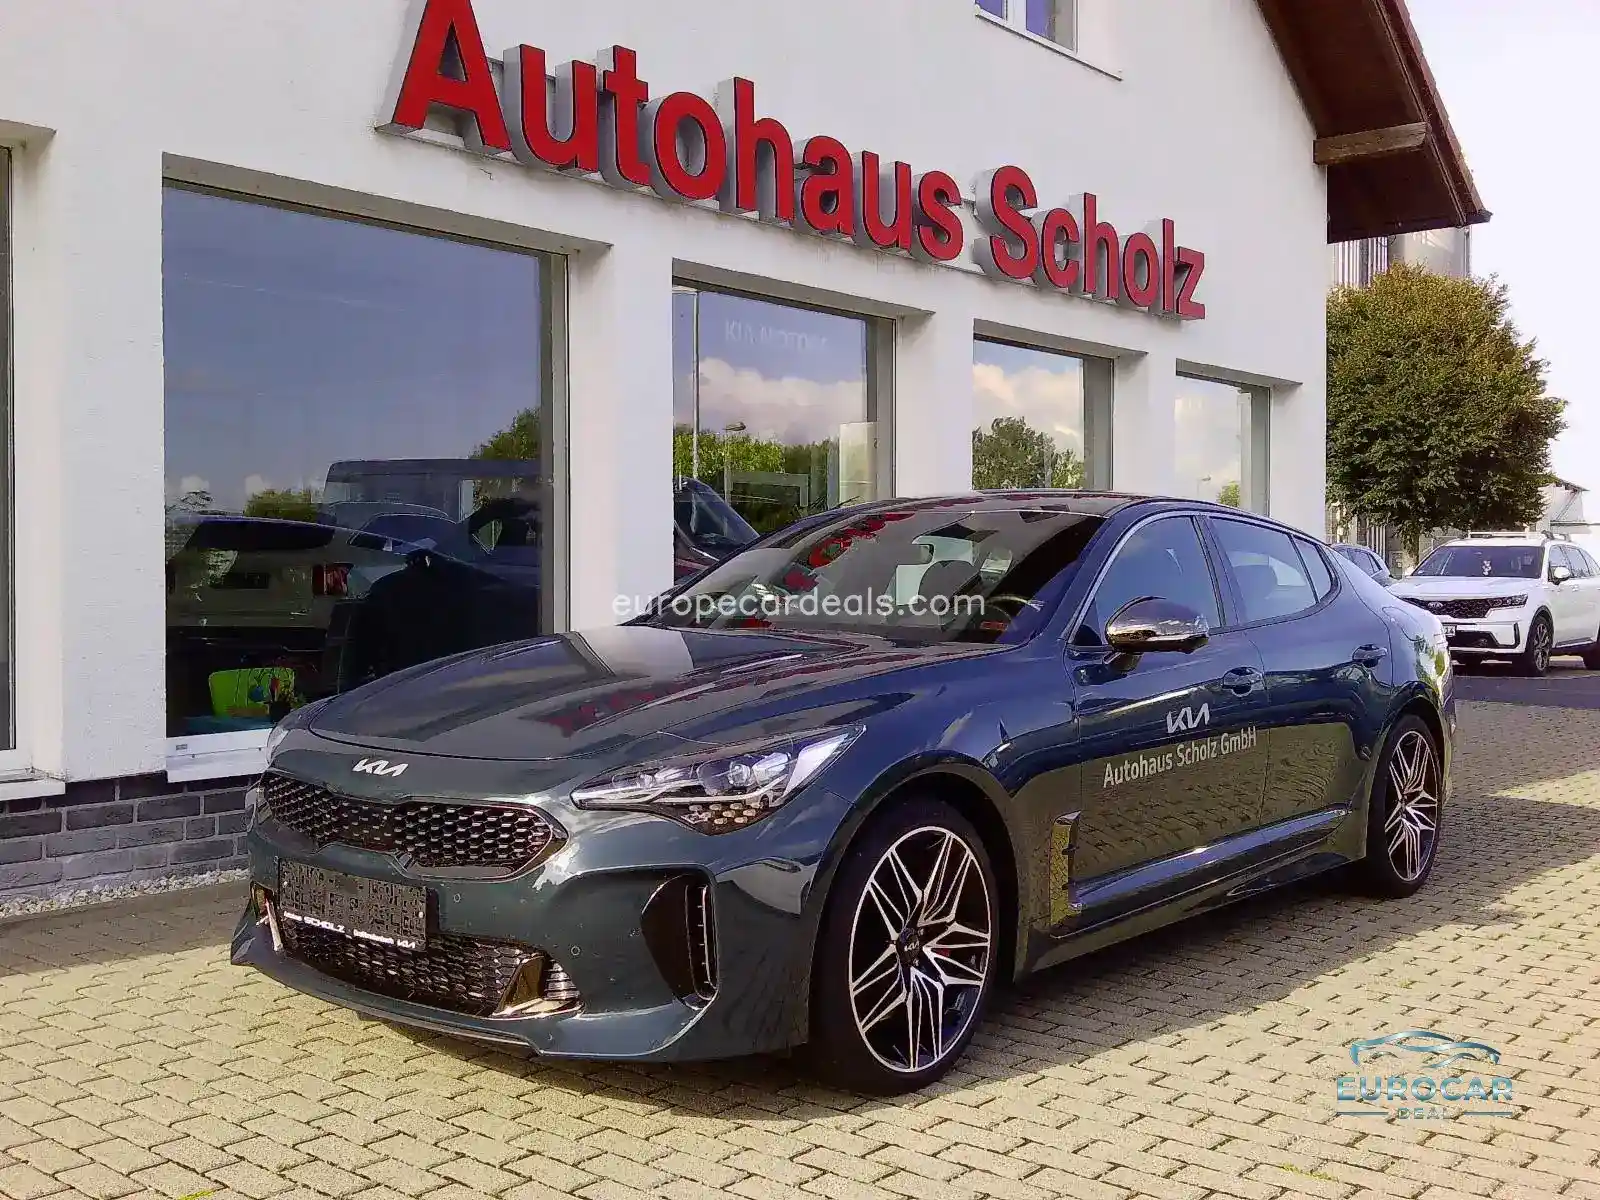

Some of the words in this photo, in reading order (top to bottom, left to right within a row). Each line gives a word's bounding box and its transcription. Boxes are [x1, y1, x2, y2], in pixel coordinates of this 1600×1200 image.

[388, 0, 964, 262] Autohaus
[985, 164, 1206, 321] Scholz
[1166, 702, 1210, 734] KIA
[352, 757, 409, 777] KIA
[1103, 751, 1173, 788] Autohaus
[1176, 736, 1217, 767] Scholz
[1220, 725, 1257, 755] GmbH
